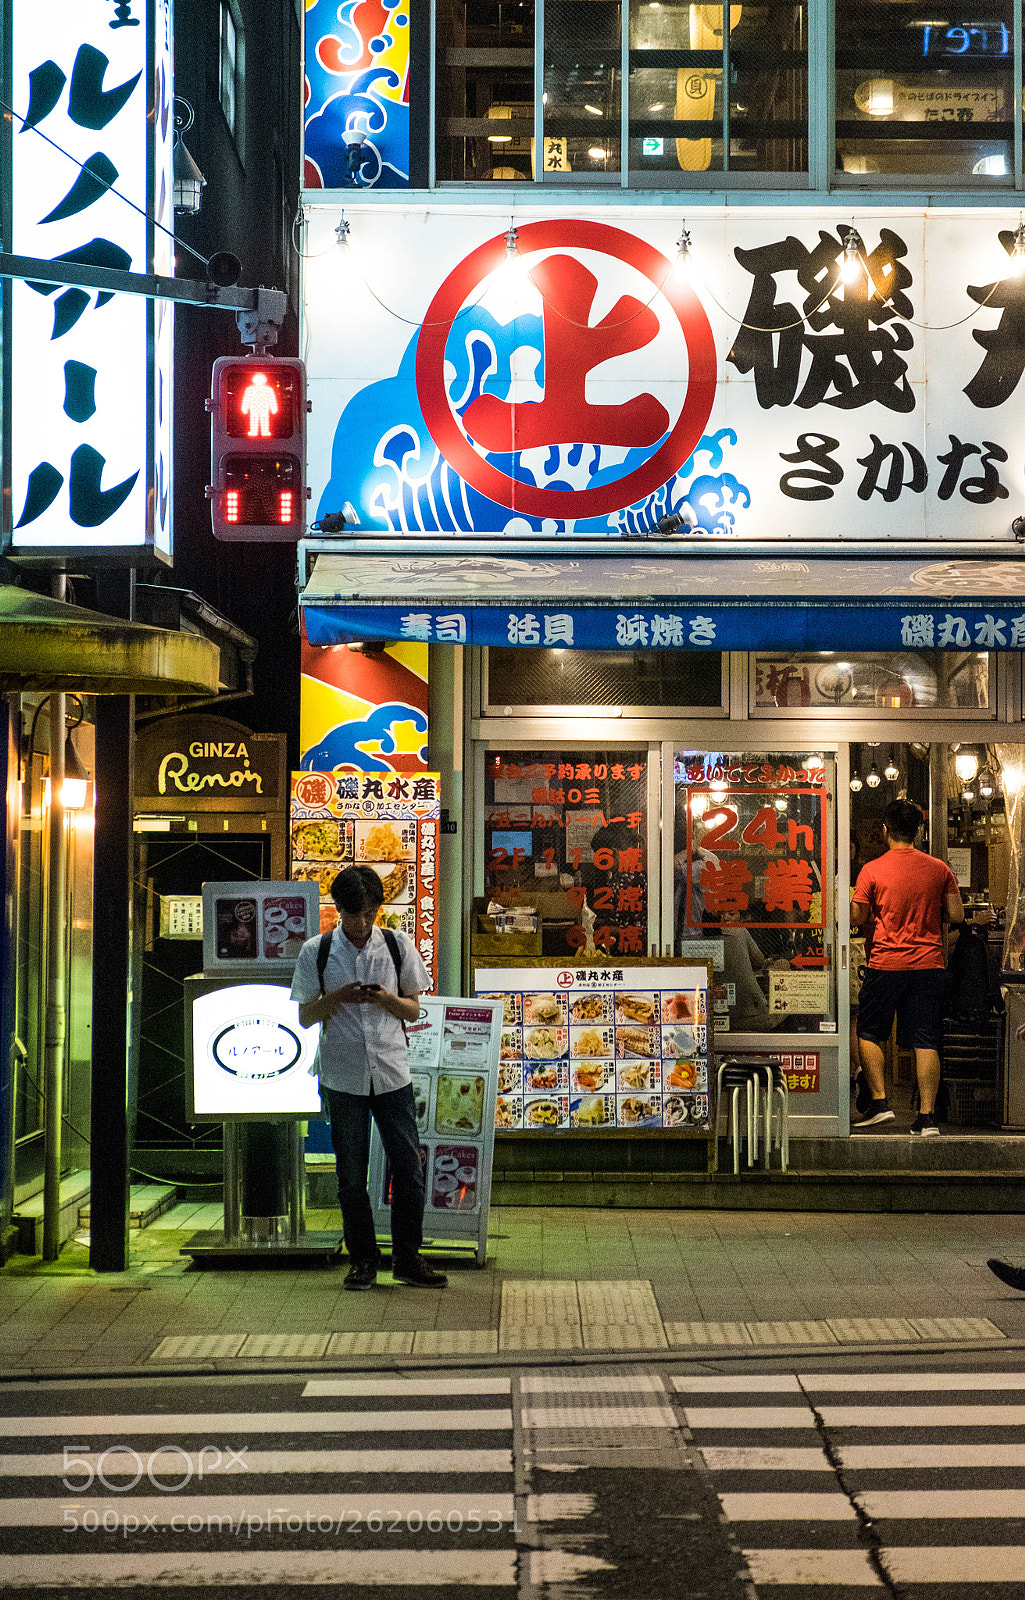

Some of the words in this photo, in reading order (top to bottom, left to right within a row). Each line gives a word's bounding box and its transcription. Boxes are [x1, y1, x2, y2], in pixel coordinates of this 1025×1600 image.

[13, 43, 144, 530] ルノアール
[779, 432, 1010, 504] さかな
[400, 614, 467, 644] 寿司
[507, 614, 575, 646] 活貝
[615, 614, 717, 646] 浜焼き
[189, 742, 249, 758] GINZA
[158, 752, 263, 795] Renoir
[300, 778, 327, 804] 磯
[336, 777, 436, 801] 磯丸水産
[700, 858, 814, 912] 営業
[806, 947, 824, 956] 入口
[575, 969, 624, 981] 磯丸水産
[228, 1046, 284, 1056] ルノアール
[783, 1074, 816, 1089] ます!
